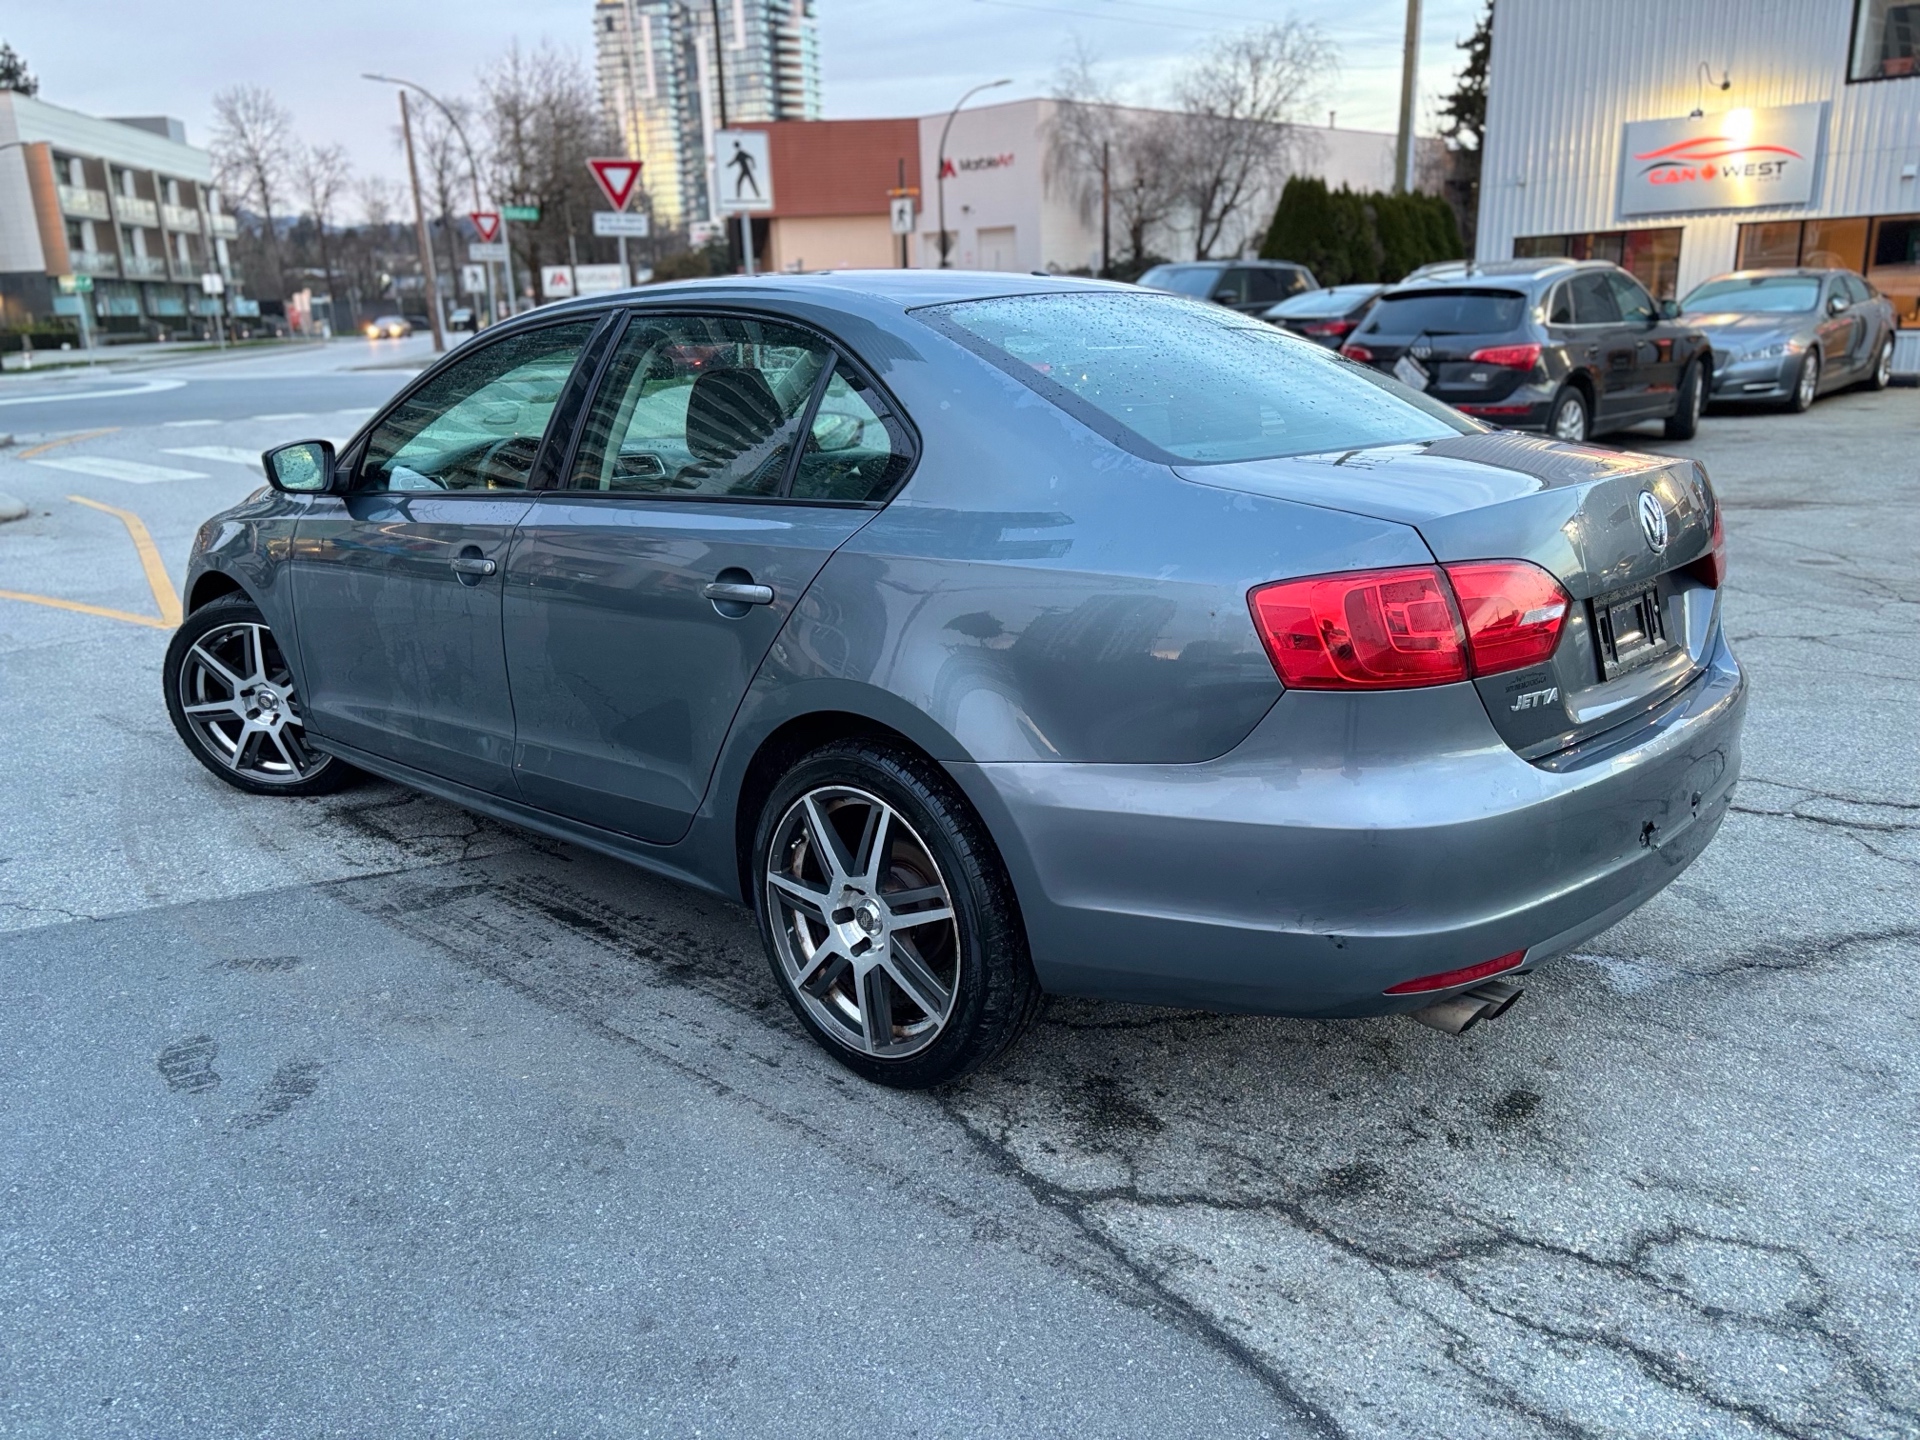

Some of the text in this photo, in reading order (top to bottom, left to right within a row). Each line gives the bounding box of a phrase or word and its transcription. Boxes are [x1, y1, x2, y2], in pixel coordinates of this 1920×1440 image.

[1649, 160, 1789, 185] CAN WEST
[1510, 687, 1558, 712] JETTA
